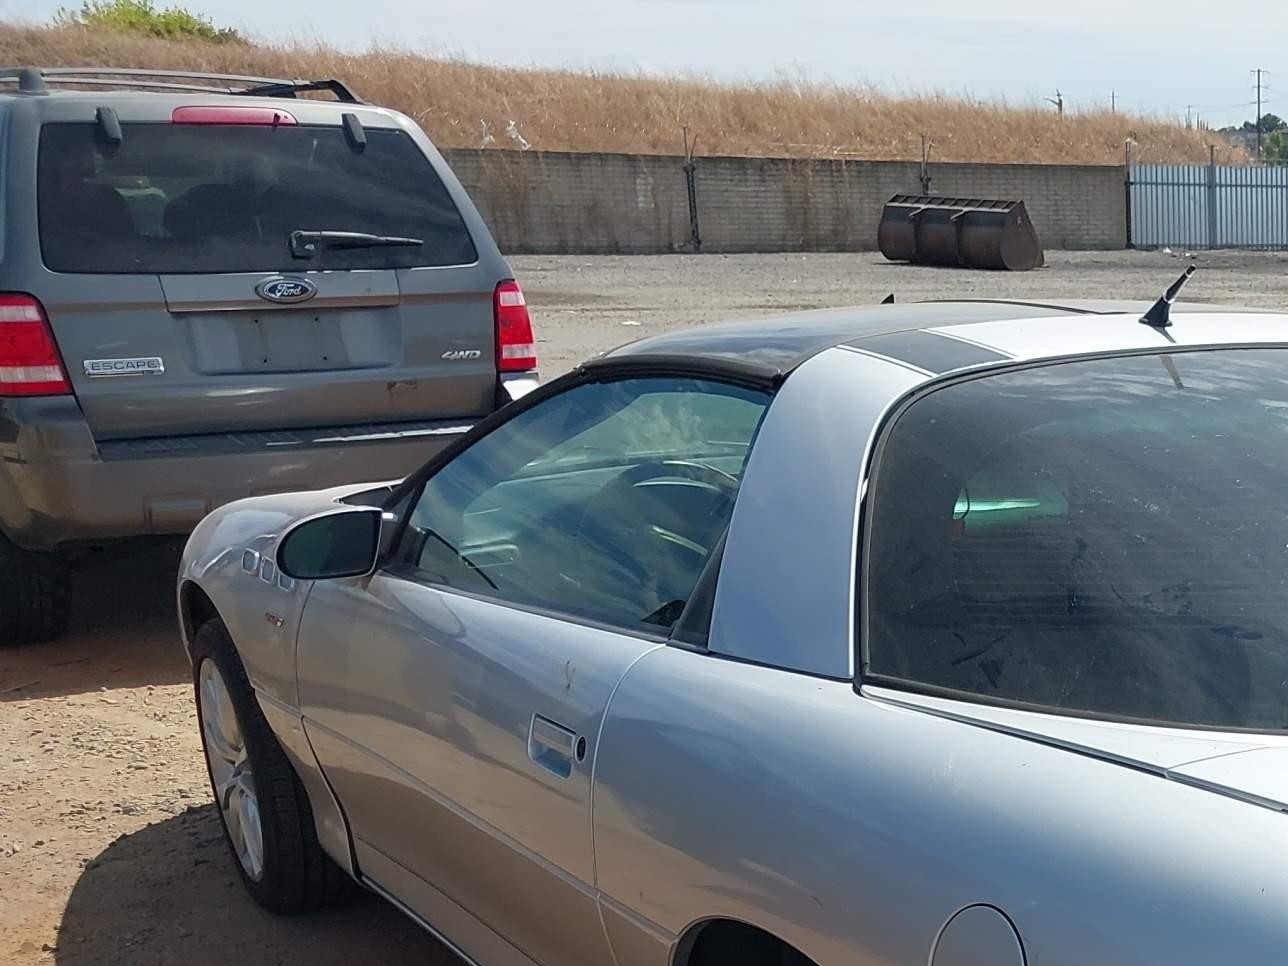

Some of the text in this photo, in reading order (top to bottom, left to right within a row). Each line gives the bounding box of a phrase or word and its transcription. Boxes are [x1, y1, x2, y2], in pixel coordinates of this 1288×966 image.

[275, 283, 302, 297] Ford
[440, 350, 481, 360] 4WD
[91, 360, 158, 371] ESCAPE
